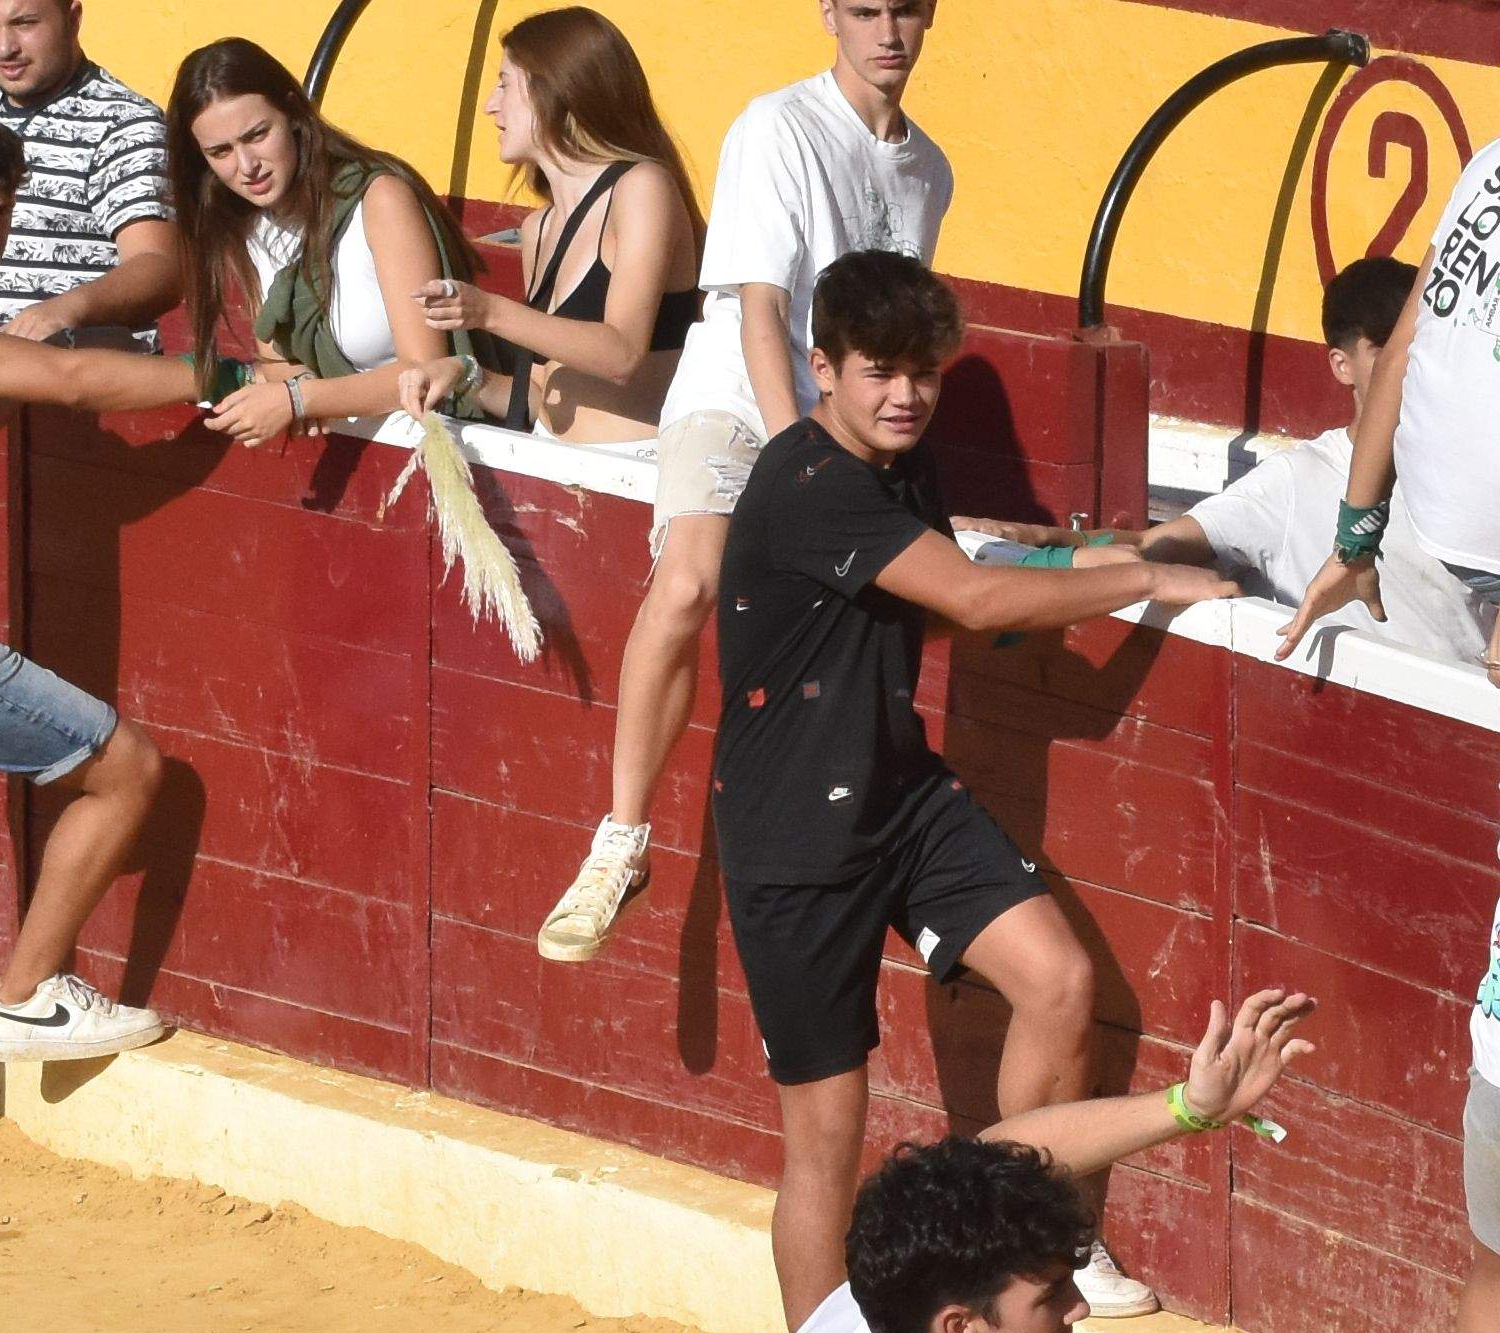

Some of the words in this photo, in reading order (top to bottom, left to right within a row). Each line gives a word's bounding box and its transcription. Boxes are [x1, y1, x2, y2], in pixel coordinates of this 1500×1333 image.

[1365, 110, 1429, 260] 2
[1422, 265, 1461, 318] ZO
[1439, 227, 1500, 297] REN
